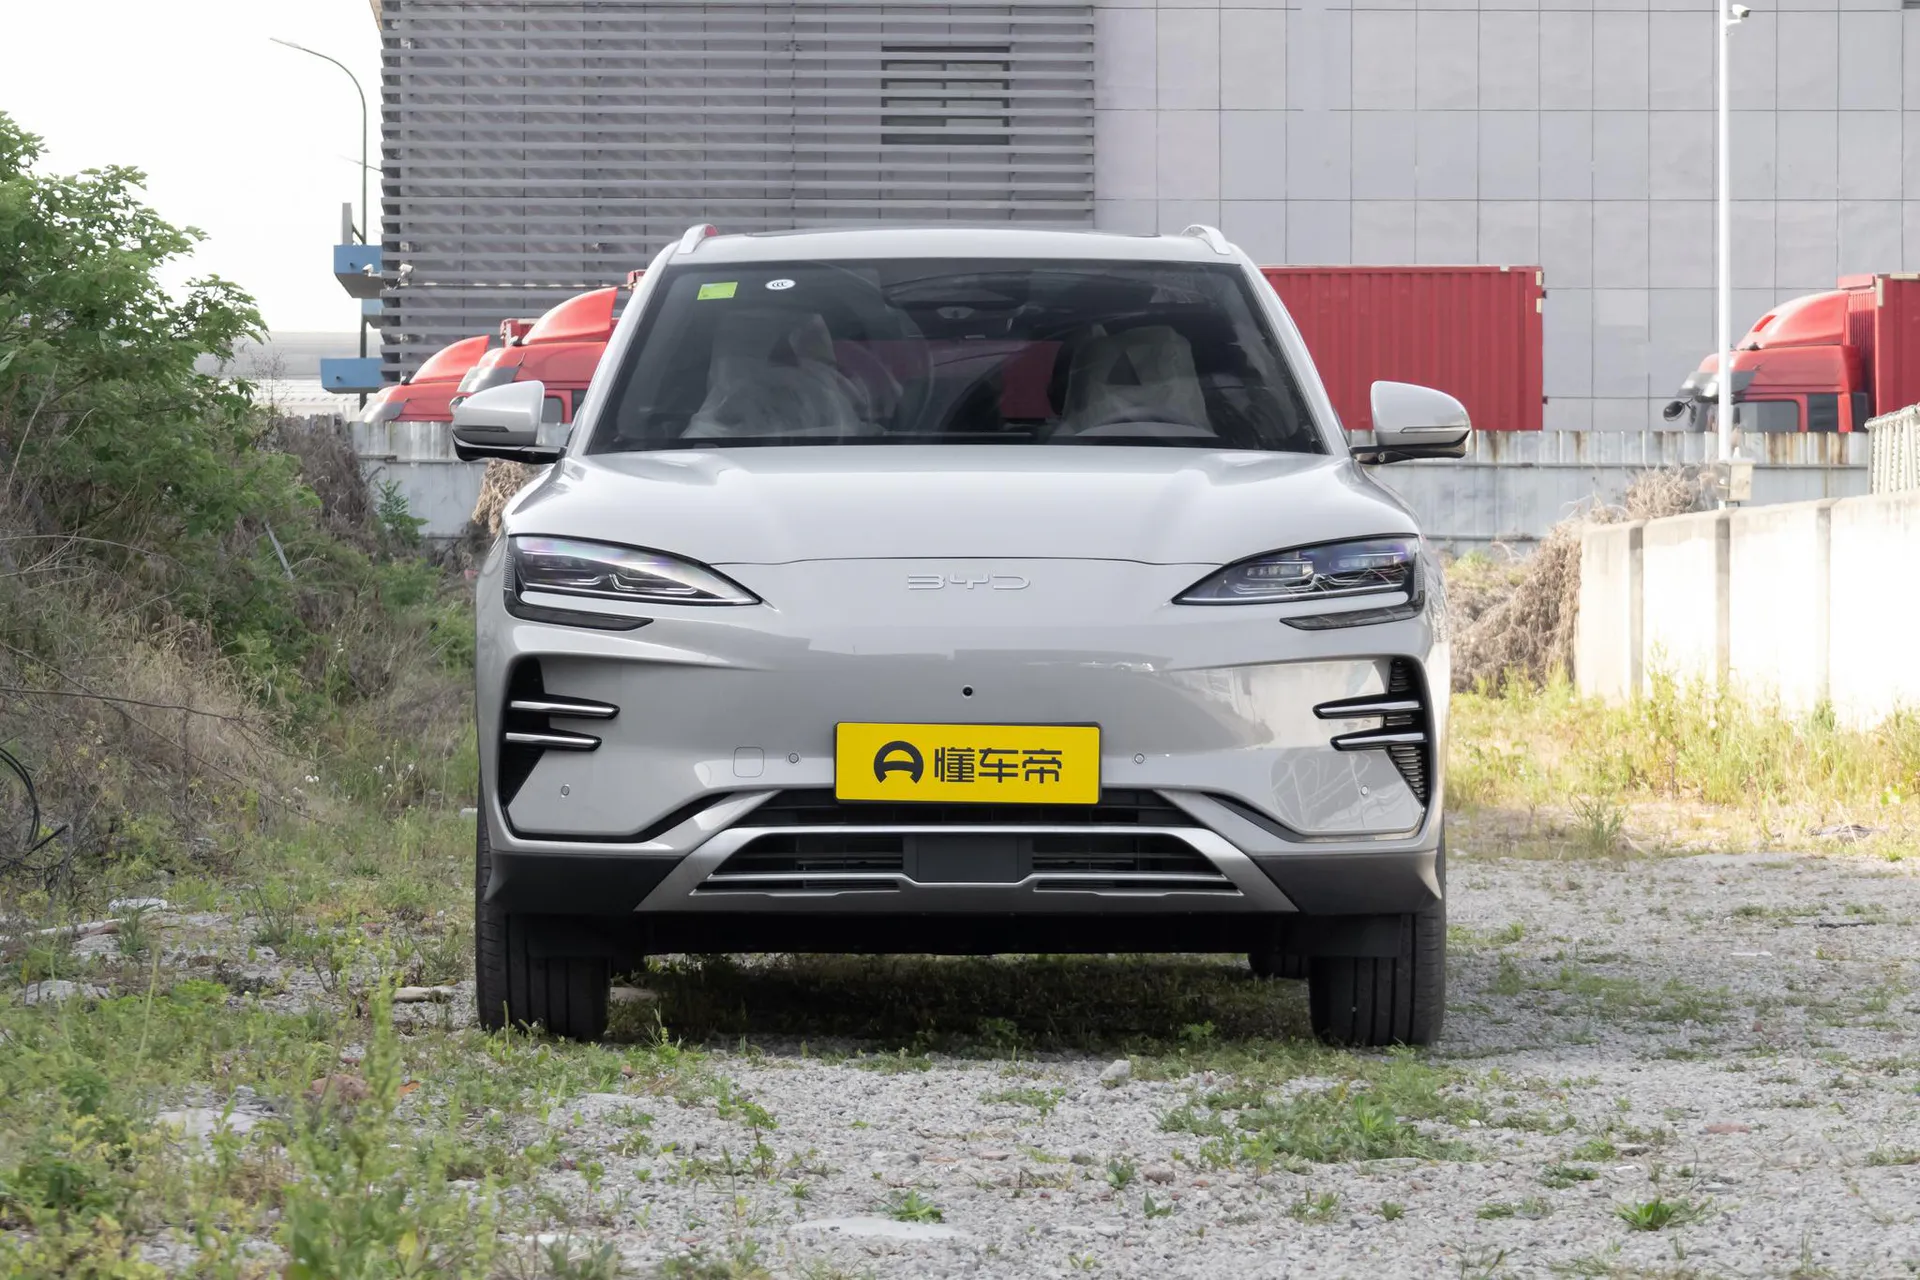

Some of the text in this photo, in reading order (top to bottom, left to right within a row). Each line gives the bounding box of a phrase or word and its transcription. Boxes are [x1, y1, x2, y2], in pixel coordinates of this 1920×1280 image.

[908, 573, 1030, 590] BYD
[934, 746, 1062, 784] 懂车帝
